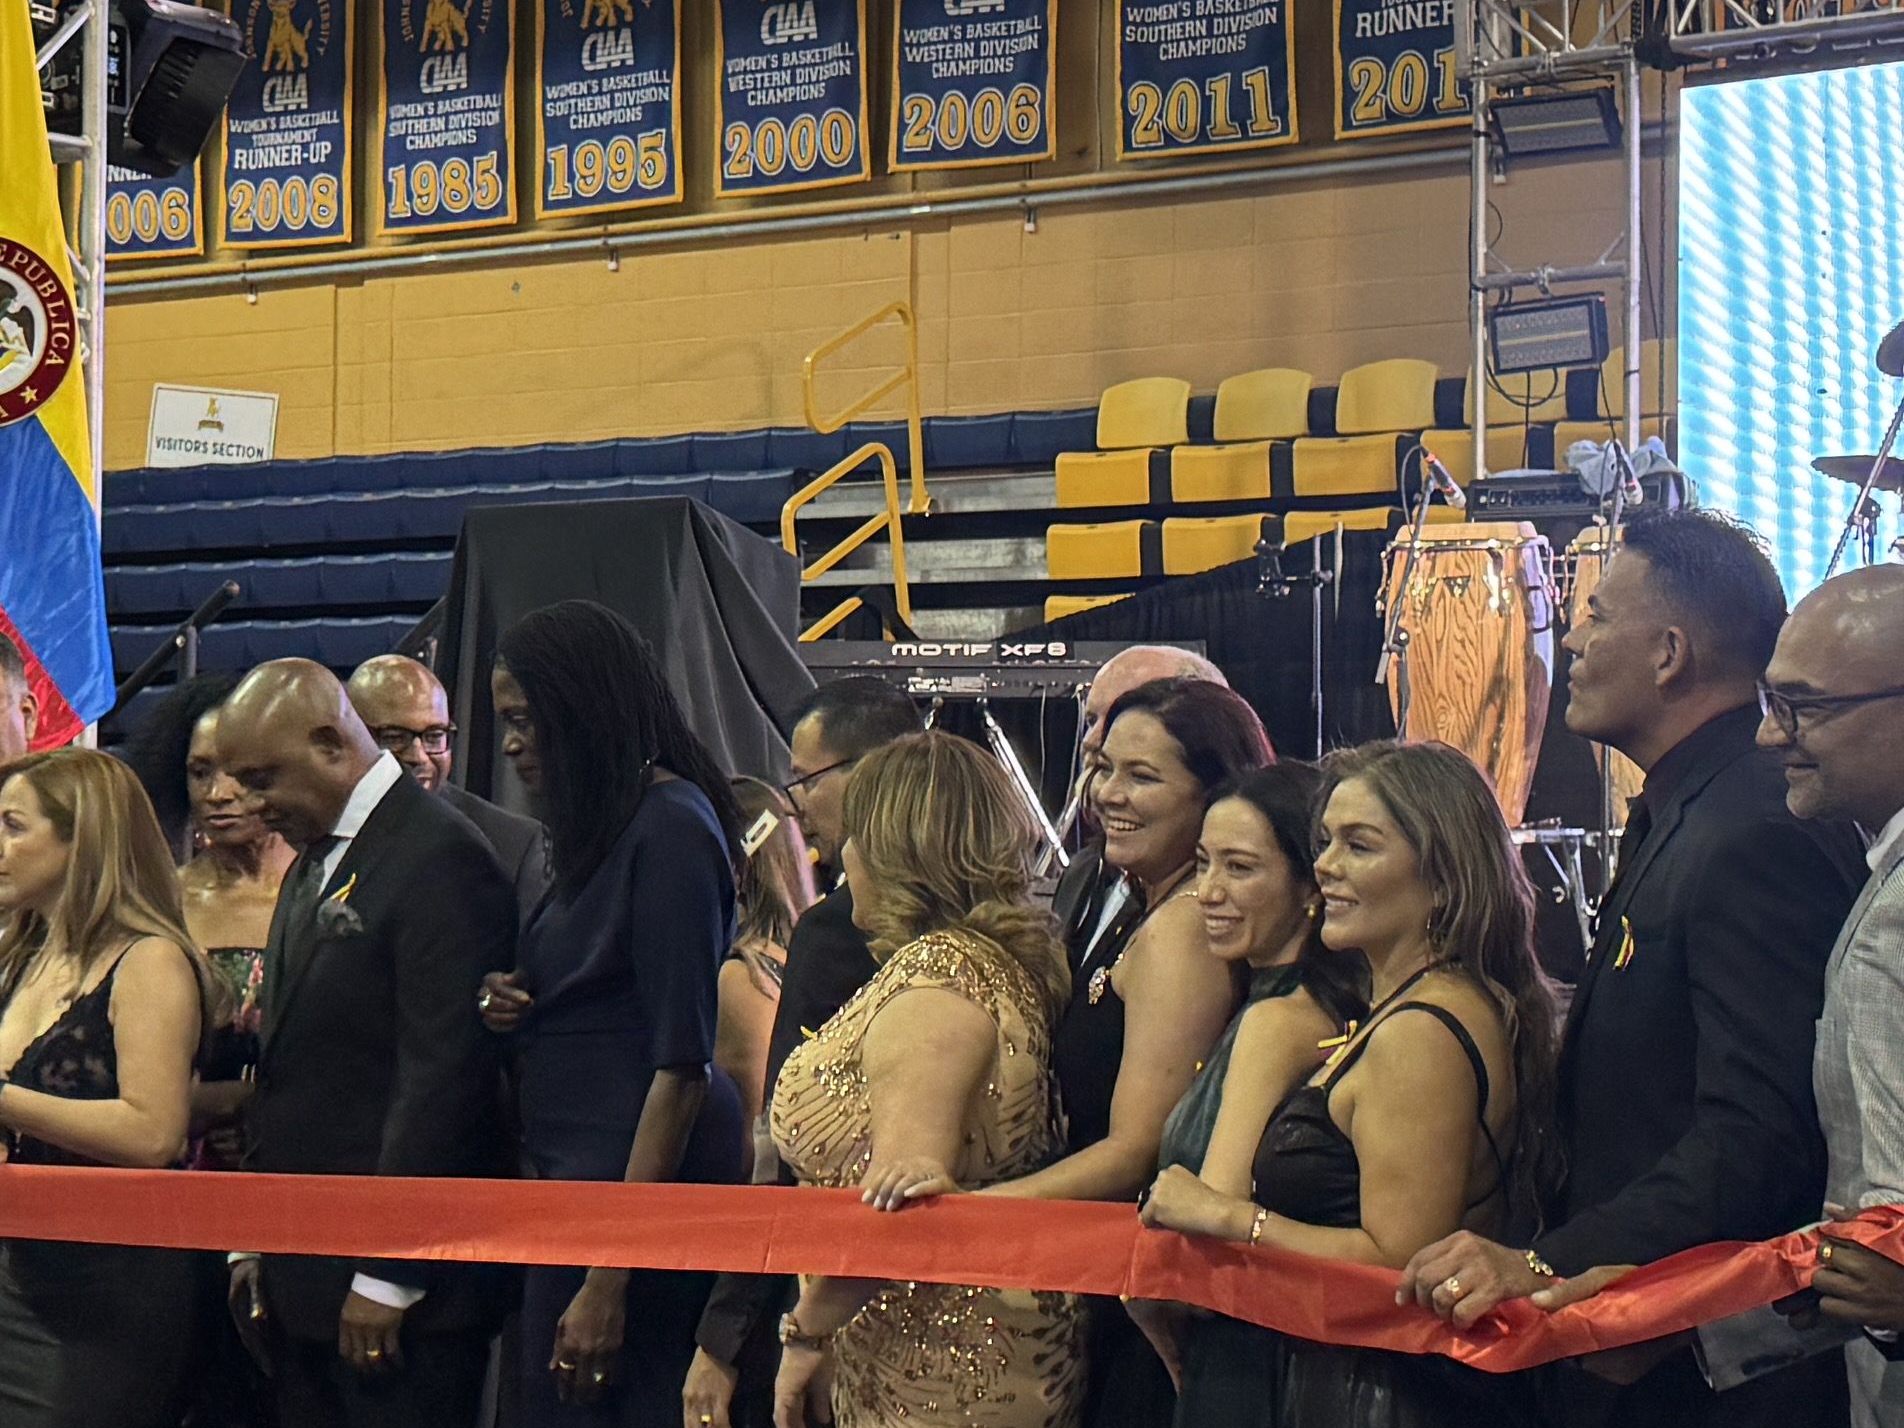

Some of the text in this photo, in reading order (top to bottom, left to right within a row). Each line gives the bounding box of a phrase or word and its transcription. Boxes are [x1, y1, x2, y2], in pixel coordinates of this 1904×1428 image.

[760, 0, 819, 47] CIAA
[1125, 7, 1278, 44] SOUTHERN DIVISION
[1127, 1, 1192, 24] WOMEN'S
[903, 14, 1042, 45] WOMEN'S BASKETBALL
[581, 27, 635, 72] CIAA
[726, 41, 855, 74] WOMEN'S BASKETBALL
[904, 32, 1039, 63] WESTERN DIVISION
[1159, 33, 1247, 61] CHAMPIONS
[420, 51, 468, 94] CIAA
[545, 68, 672, 100] WOMEN'S BASKETBALL
[728, 60, 851, 93] WESTERN DIVISION
[932, 56, 1014, 80] CHAMPIONS
[262, 73, 309, 113] CIAA
[545, 85, 670, 118] SOUTHERN DIVISION
[746, 82, 827, 107] CHAMPIONS
[1348, 47, 1470, 125] 201
[388, 108, 502, 138] SOUTHERN DIVISION
[389, 98, 436, 121] WOMEN'S
[569, 106, 644, 131] CHAMPIONS
[902, 82, 1042, 153] 2006
[1128, 65, 1282, 149] 2011
[233, 141, 333, 170] RUNNER-UP
[405, 128, 478, 151] CHAMPIONS
[724, 106, 856, 179] 2000
[547, 128, 667, 202] 1995
[387, 149, 503, 219] 1985
[106, 187, 192, 245] 006
[228, 172, 339, 233] 2008
[155, 436, 266, 459] VISITORS SECTION
[891, 641, 1068, 658] MOTIF XF8
